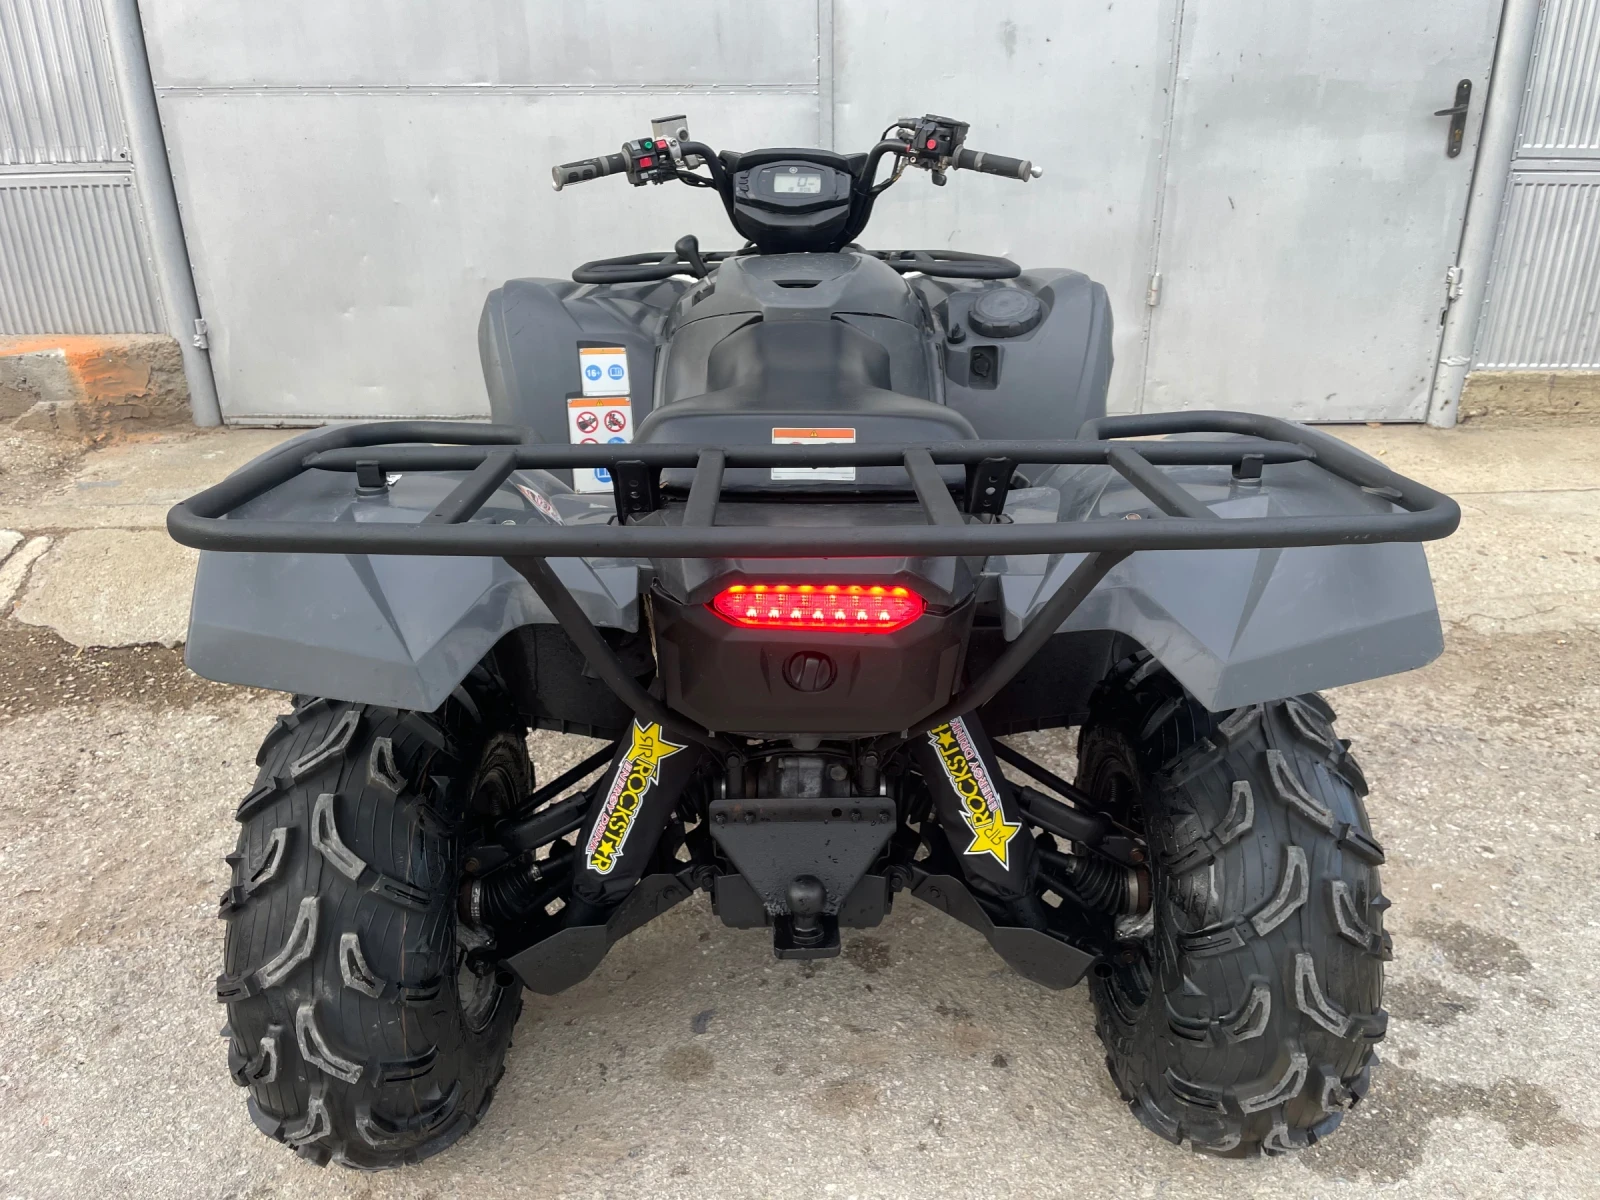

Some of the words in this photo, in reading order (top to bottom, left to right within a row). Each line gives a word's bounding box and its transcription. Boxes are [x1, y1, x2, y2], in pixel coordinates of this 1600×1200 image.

[607, 762, 633, 815] ENERGY
[968, 761, 1000, 812] ENERGY
[588, 813, 610, 854] DRINK
